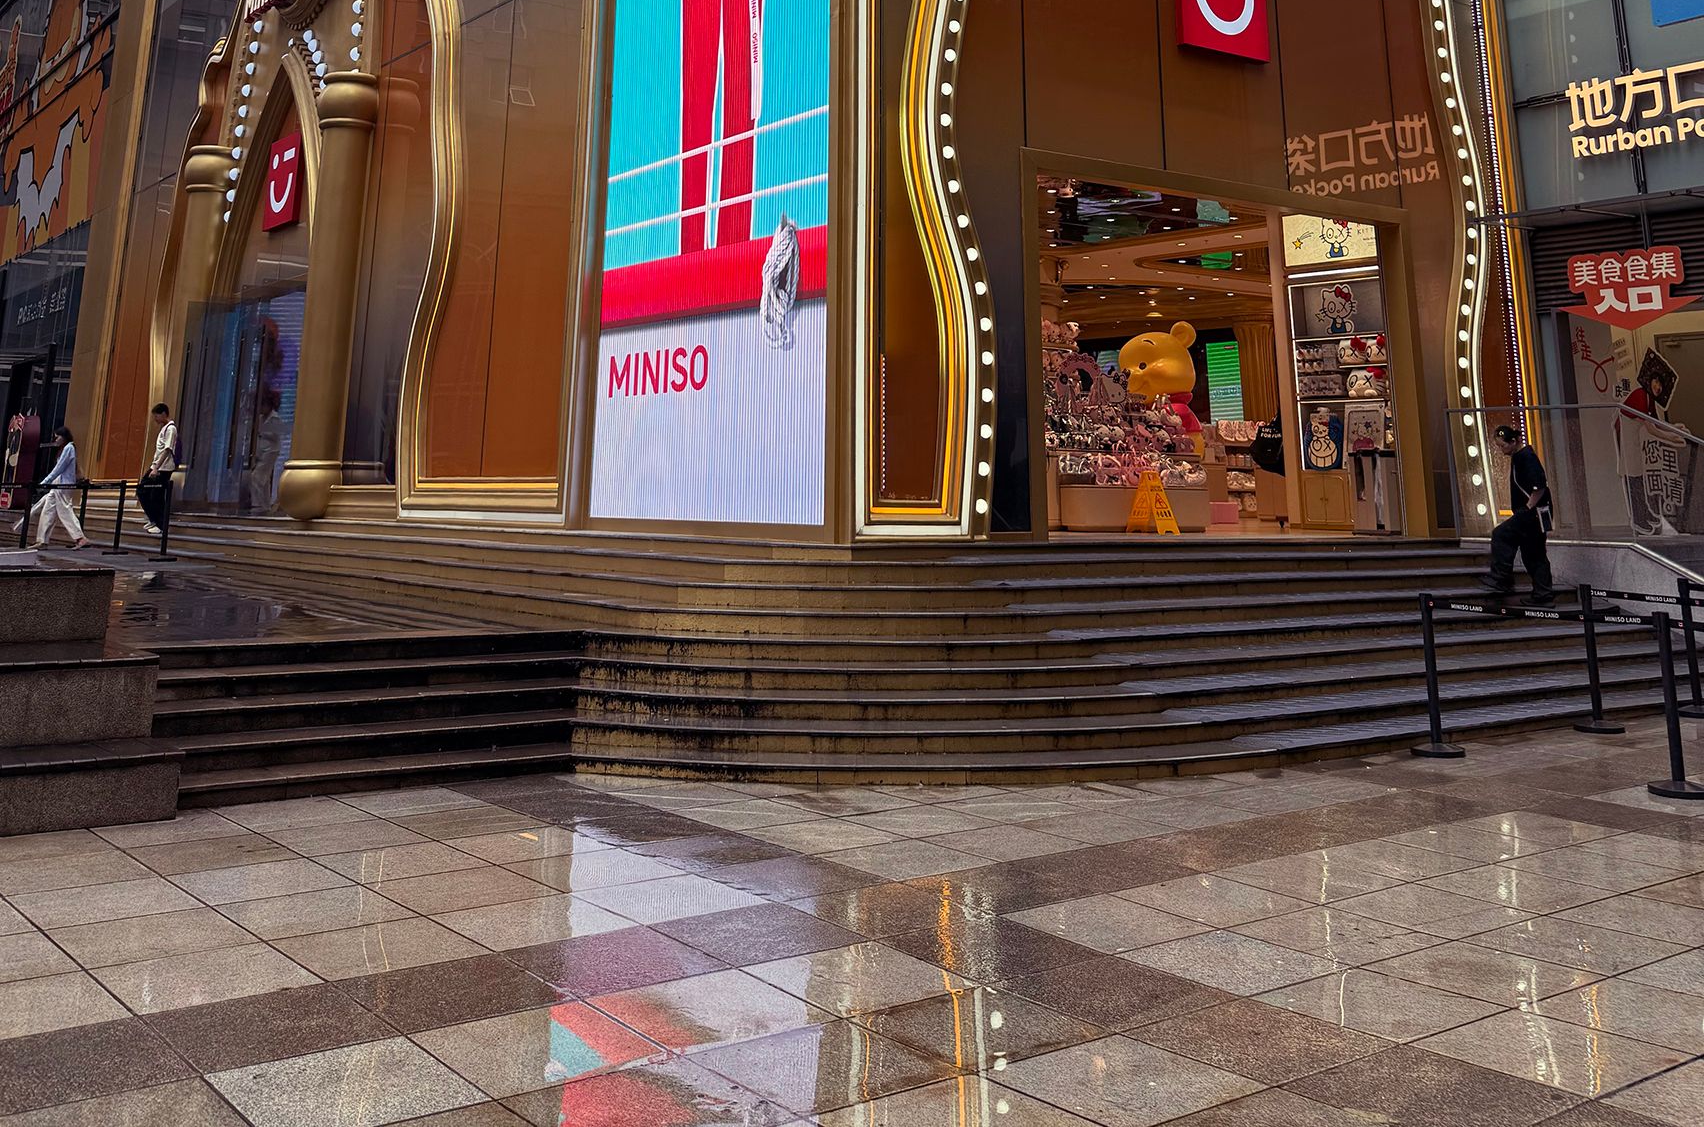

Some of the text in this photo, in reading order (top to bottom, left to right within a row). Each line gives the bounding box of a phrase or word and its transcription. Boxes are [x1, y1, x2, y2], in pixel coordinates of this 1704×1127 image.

[1571, 125, 1673, 158] Rurban
[1573, 252, 1677, 287] 美食食集
[1594, 285, 1663, 314] 入口
[608, 345, 709, 398] MINISO
[1451, 603, 1468, 611] MINISO
[1525, 610, 1544, 618] MINISO
[1604, 615, 1625, 623] MINISO
